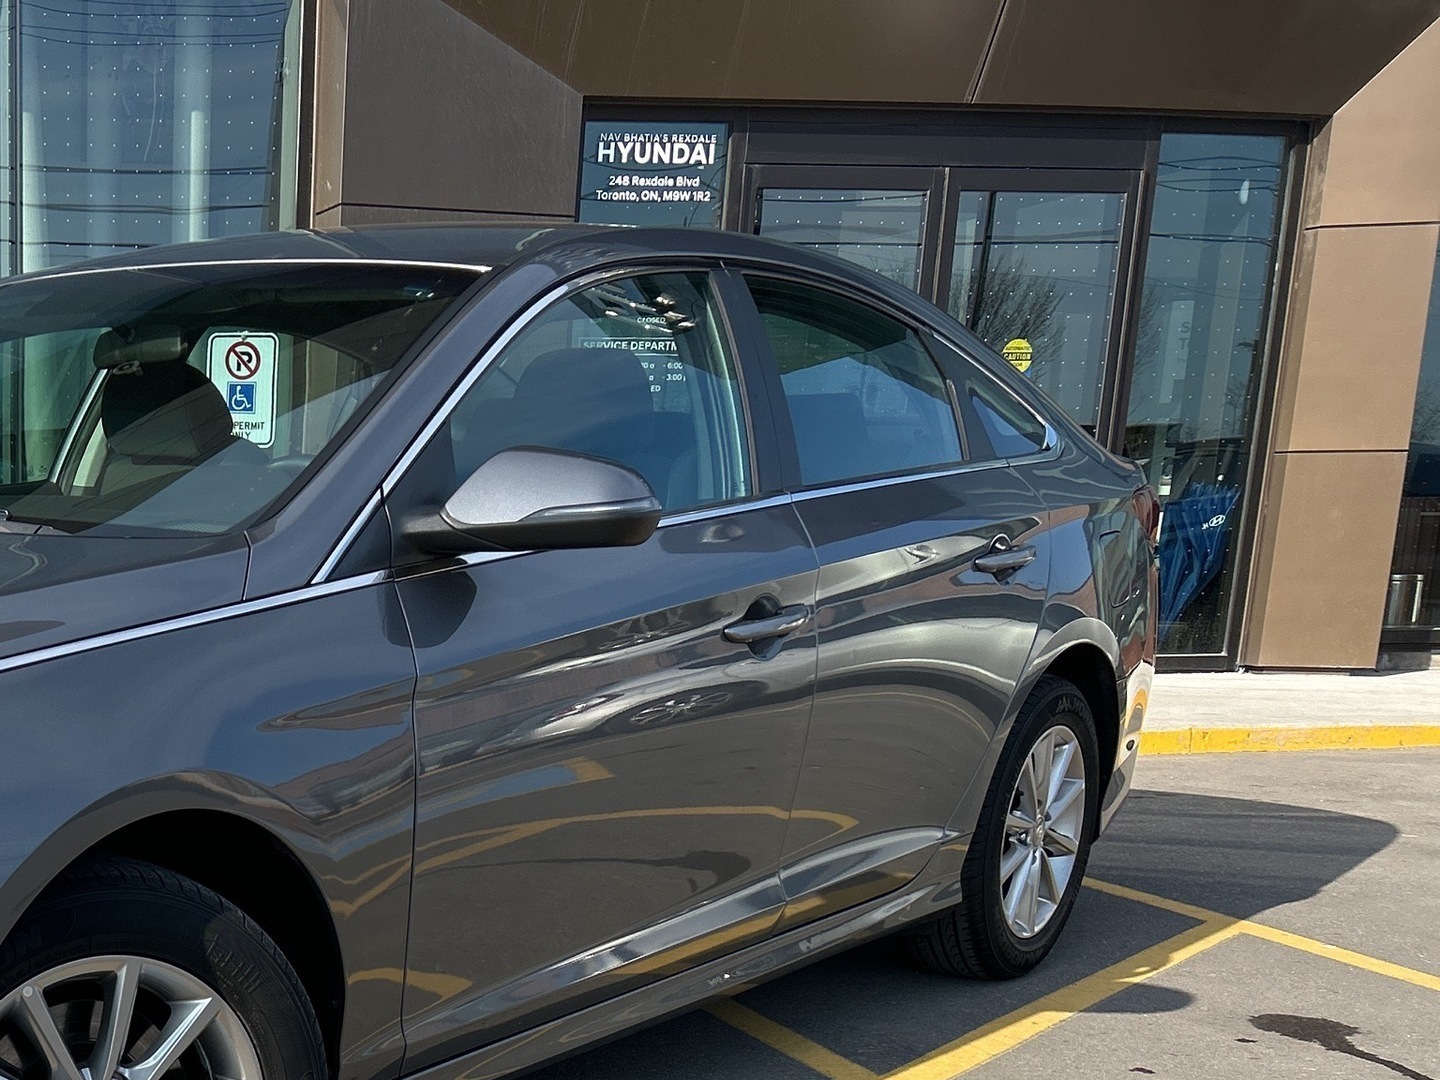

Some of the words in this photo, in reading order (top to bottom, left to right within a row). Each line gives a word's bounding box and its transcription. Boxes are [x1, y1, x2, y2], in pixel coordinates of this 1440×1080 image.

[600, 133, 621, 141] NAV
[624, 133, 669, 143] BHATIA'S
[671, 134, 717, 144] REXDALE
[597, 142, 716, 165] HYUNDAI
[609, 175, 630, 186] 248
[632, 175, 674, 187] Rexdale
[676, 176, 700, 187] Blvd
[596, 190, 639, 202] Toronto,
[641, 190, 661, 203] ON,
[663, 190, 691, 201] M9W
[692, 191, 711, 201] 1R2
[630, 341, 677, 351] DEPARTM
[233, 421, 265, 430] PERMIT
